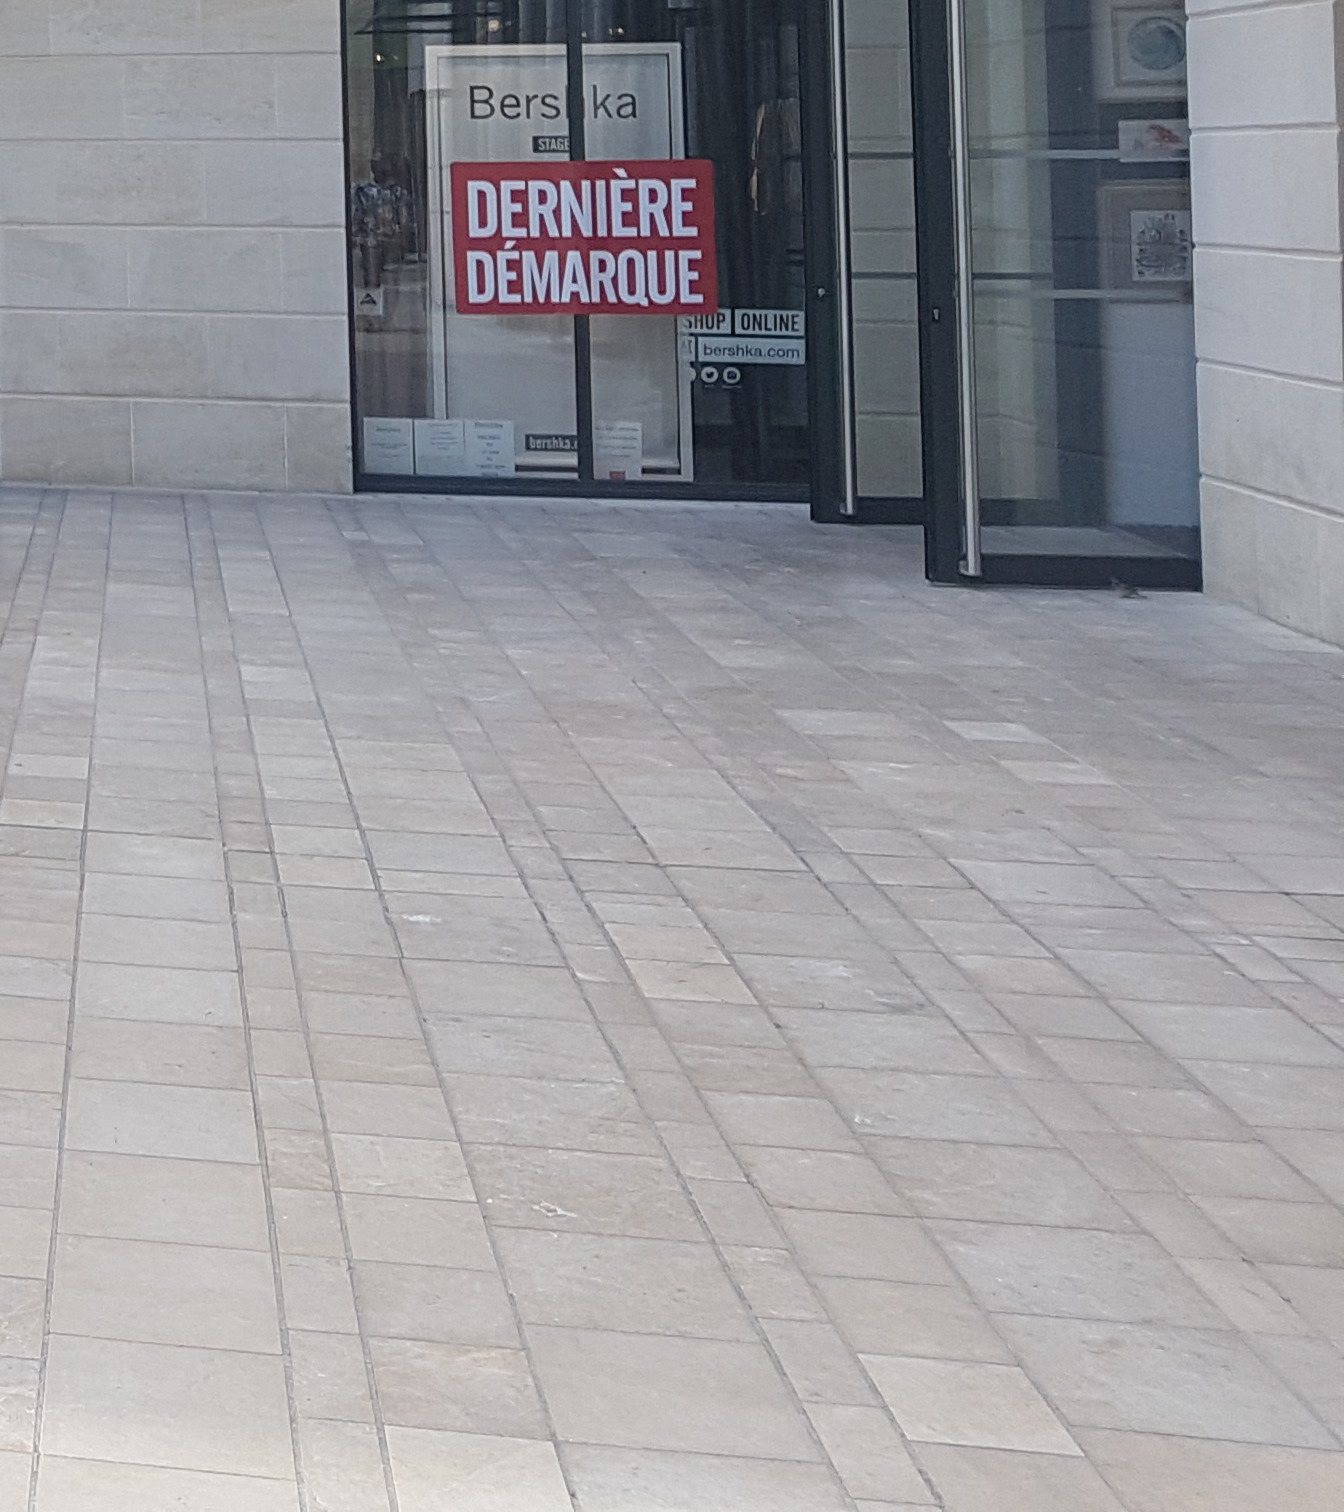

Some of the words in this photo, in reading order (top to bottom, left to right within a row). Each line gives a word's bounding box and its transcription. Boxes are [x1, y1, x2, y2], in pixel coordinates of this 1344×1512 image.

[469, 84, 638, 120] Berska
[467, 167, 698, 238] DERNIÈRE
[467, 240, 704, 307] DÉMARQUE
[741, 313, 800, 332] ONLINE
[703, 344, 800, 359] bershka.com
